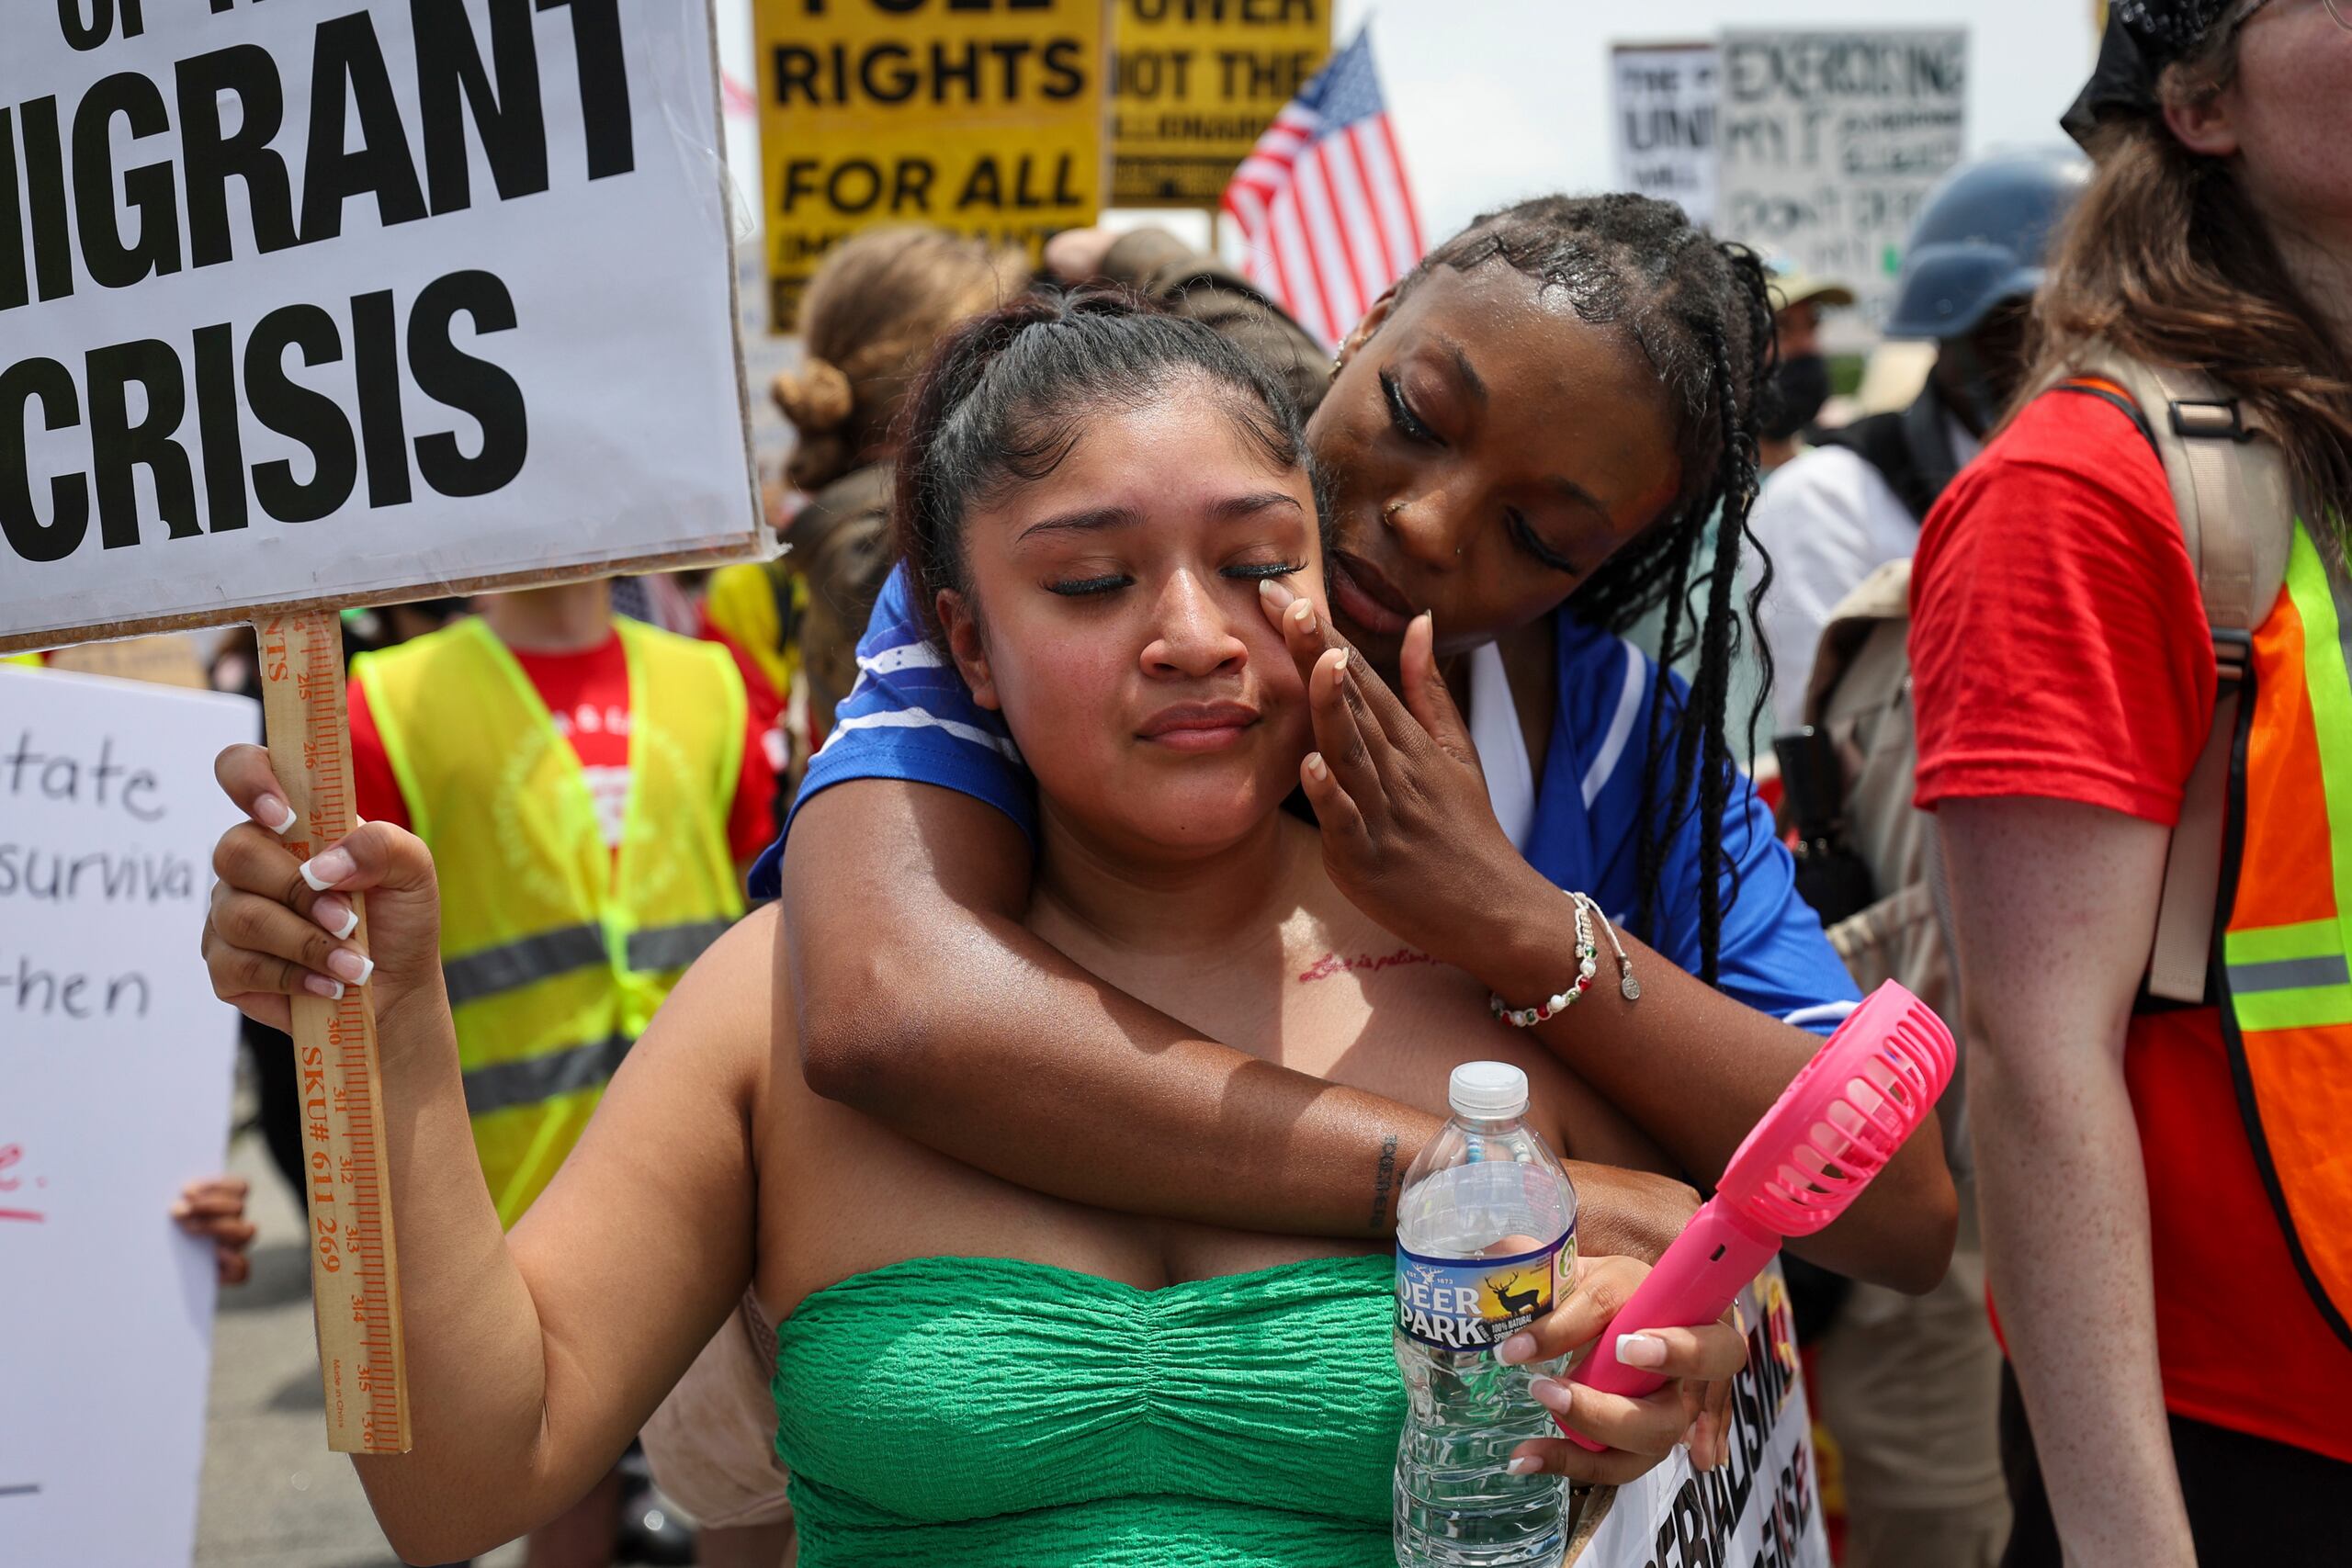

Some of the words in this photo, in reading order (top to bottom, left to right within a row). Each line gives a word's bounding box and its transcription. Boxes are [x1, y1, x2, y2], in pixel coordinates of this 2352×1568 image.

[772, 39, 1086, 107] RIGHTS
[0, 0, 635, 310] IGRANT
[784, 156, 933, 216] FOR
[957, 152, 1082, 211] ALL
[0, 269, 528, 562] CRISIS
[4, 728, 169, 823] tate
[0, 842, 213, 906] surviva
[0, 954, 150, 1018] hen
[301, 1045, 330, 1143] SKU#
[311, 1151, 335, 1206] 611
[317, 1217, 341, 1274] 269
[1400, 1271, 1483, 1315] DEER
[1400, 1301, 1487, 1349] PARK
[1491, 1320, 1508, 1334] 100%
[1508, 1314, 1532, 1329] NATURAL
